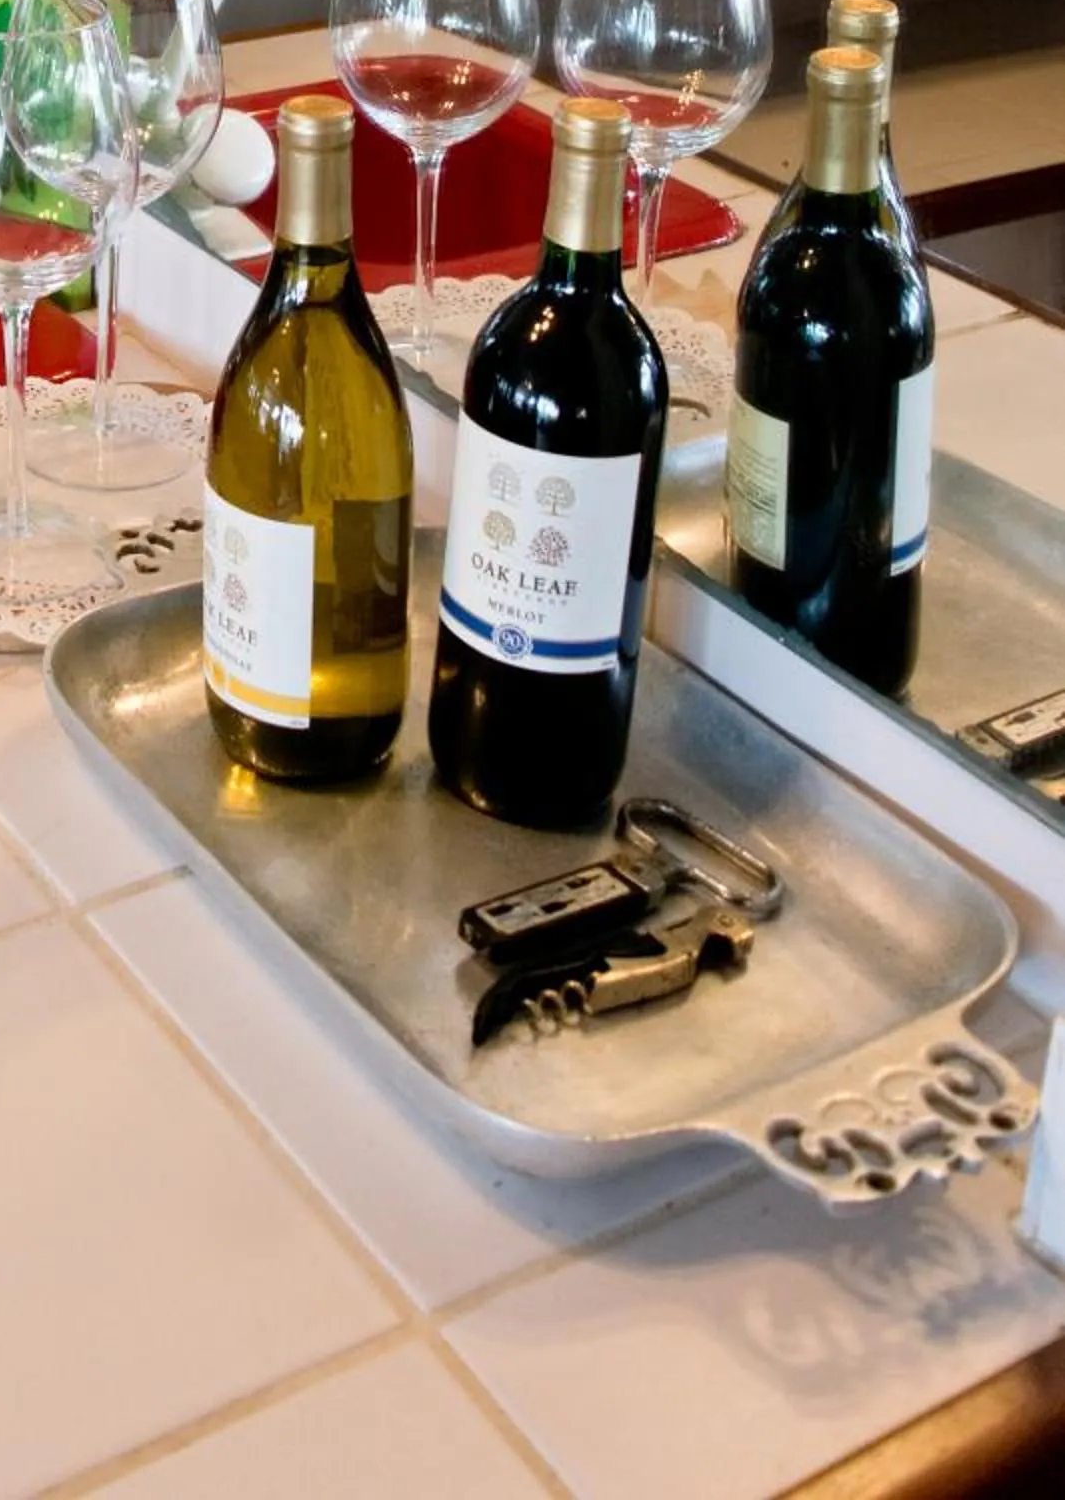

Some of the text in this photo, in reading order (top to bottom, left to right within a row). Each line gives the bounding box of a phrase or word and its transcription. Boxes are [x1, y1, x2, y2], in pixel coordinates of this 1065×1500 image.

[470, 551, 510, 584] OAK
[519, 571, 578, 596] LEAF
[488, 596, 546, 625] MERLOT
[218, 611, 257, 647] LEAF
